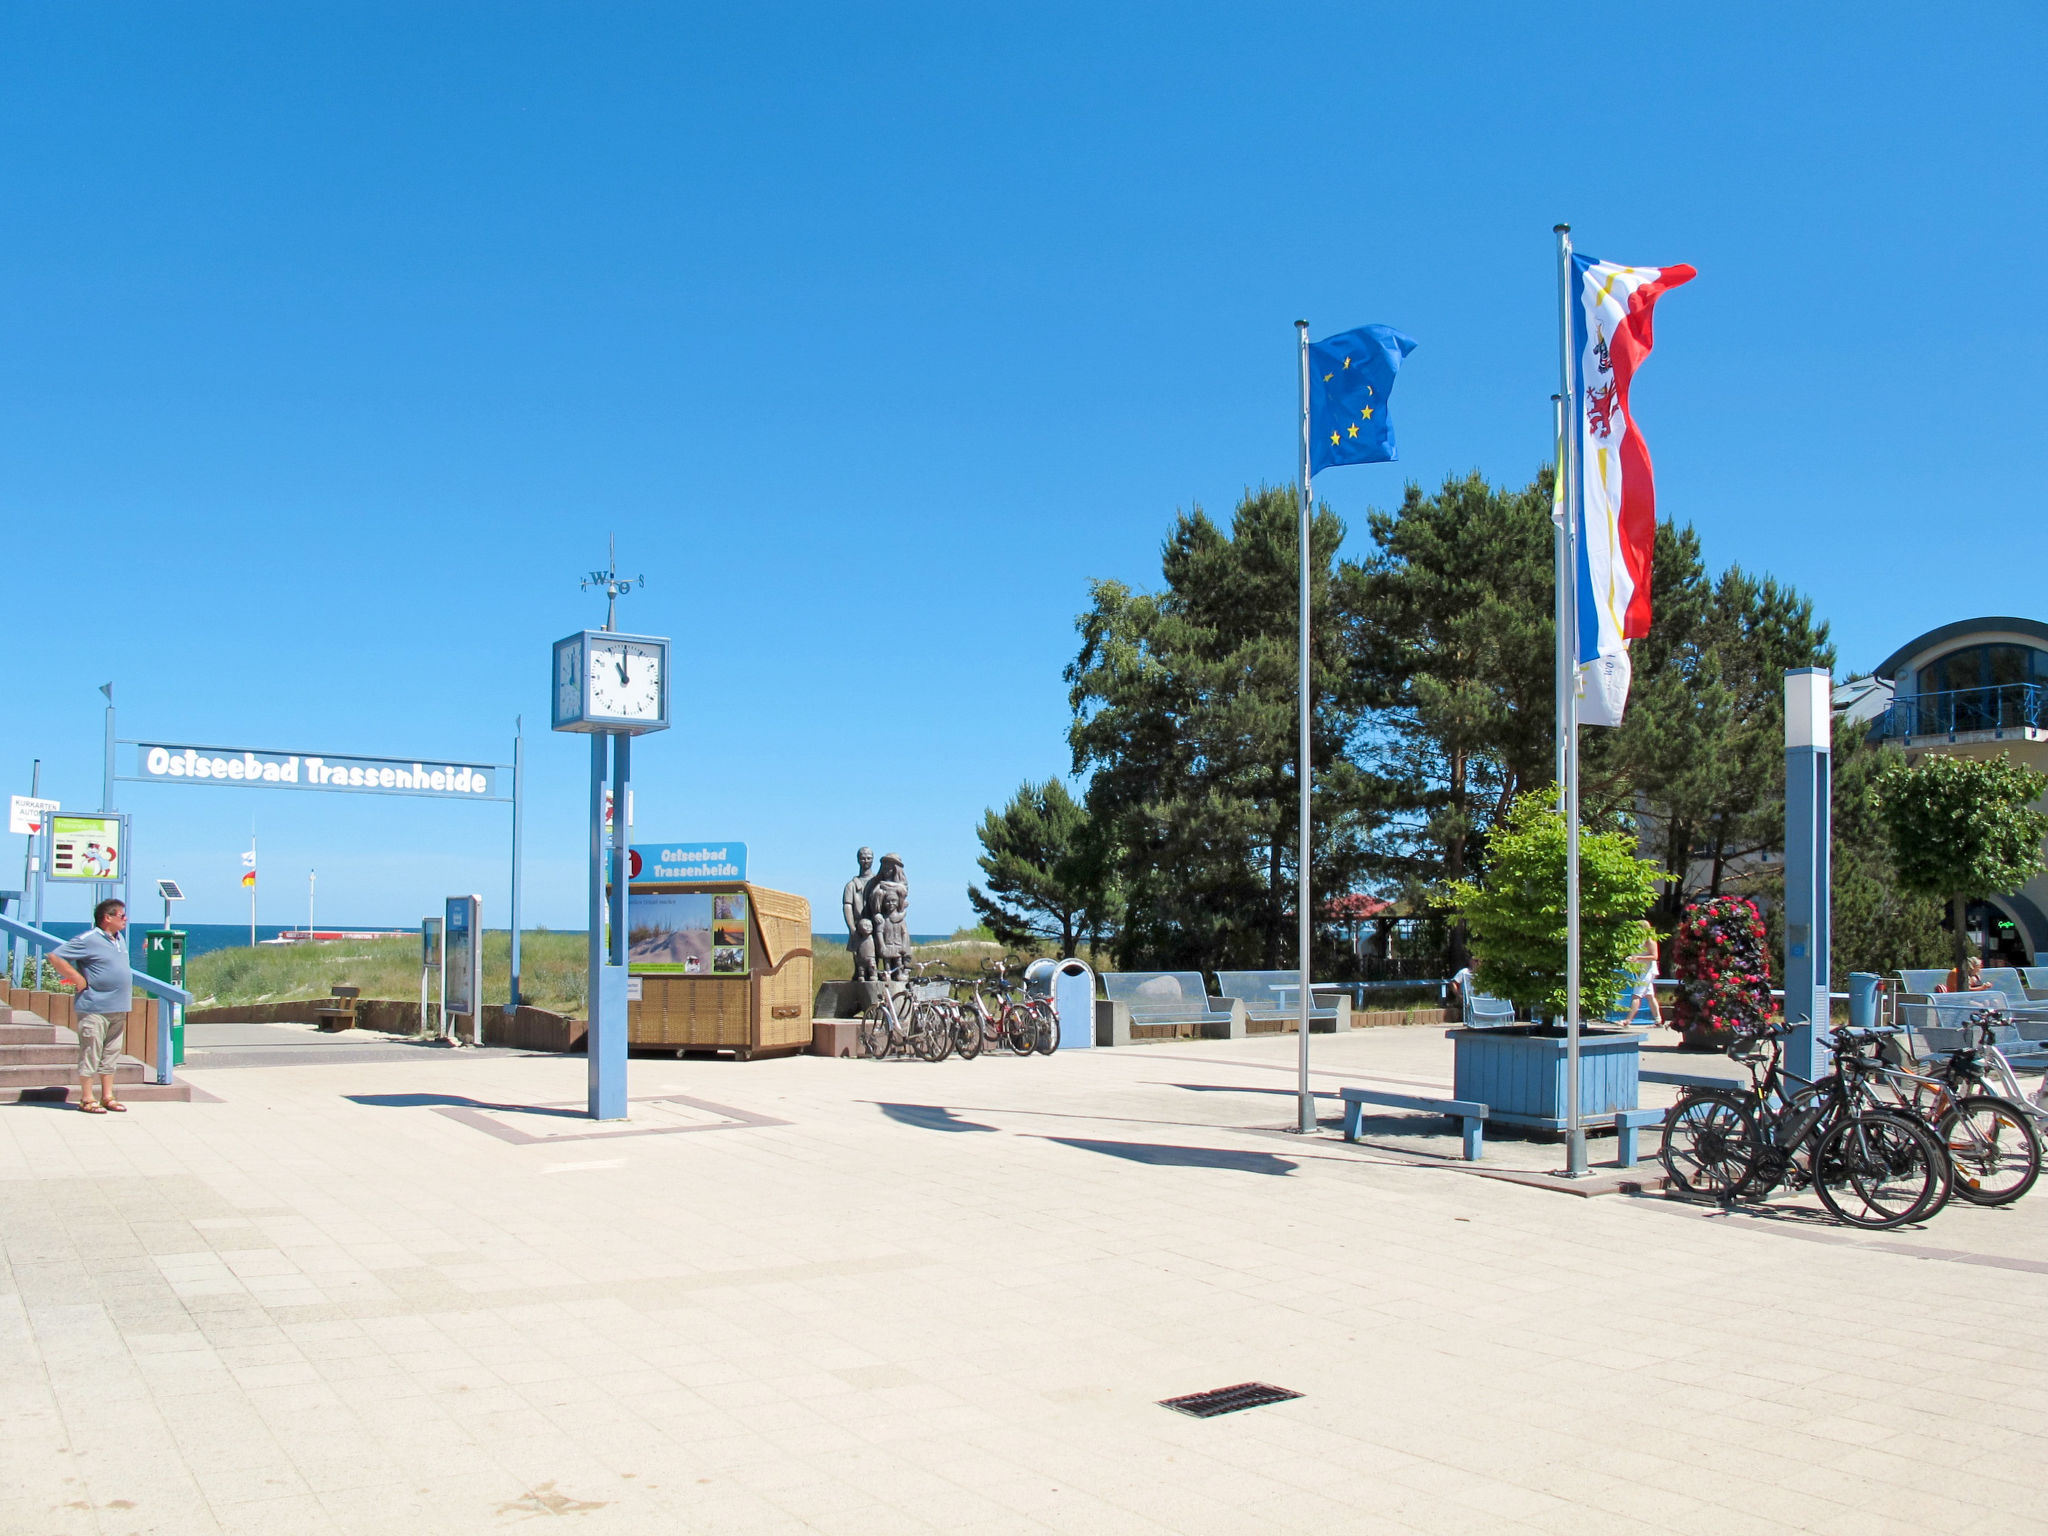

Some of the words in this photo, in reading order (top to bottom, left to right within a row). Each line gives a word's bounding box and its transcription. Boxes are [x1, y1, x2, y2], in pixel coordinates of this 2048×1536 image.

[147, 747, 300, 783] Ostseebad
[305, 757, 487, 793] Trassenheide
[15, 799, 57, 811] KURKARTEN
[661, 847, 727, 863] Ostseebad
[654, 863, 738, 877] Trassenheide
[153, 936, 165, 951] K
